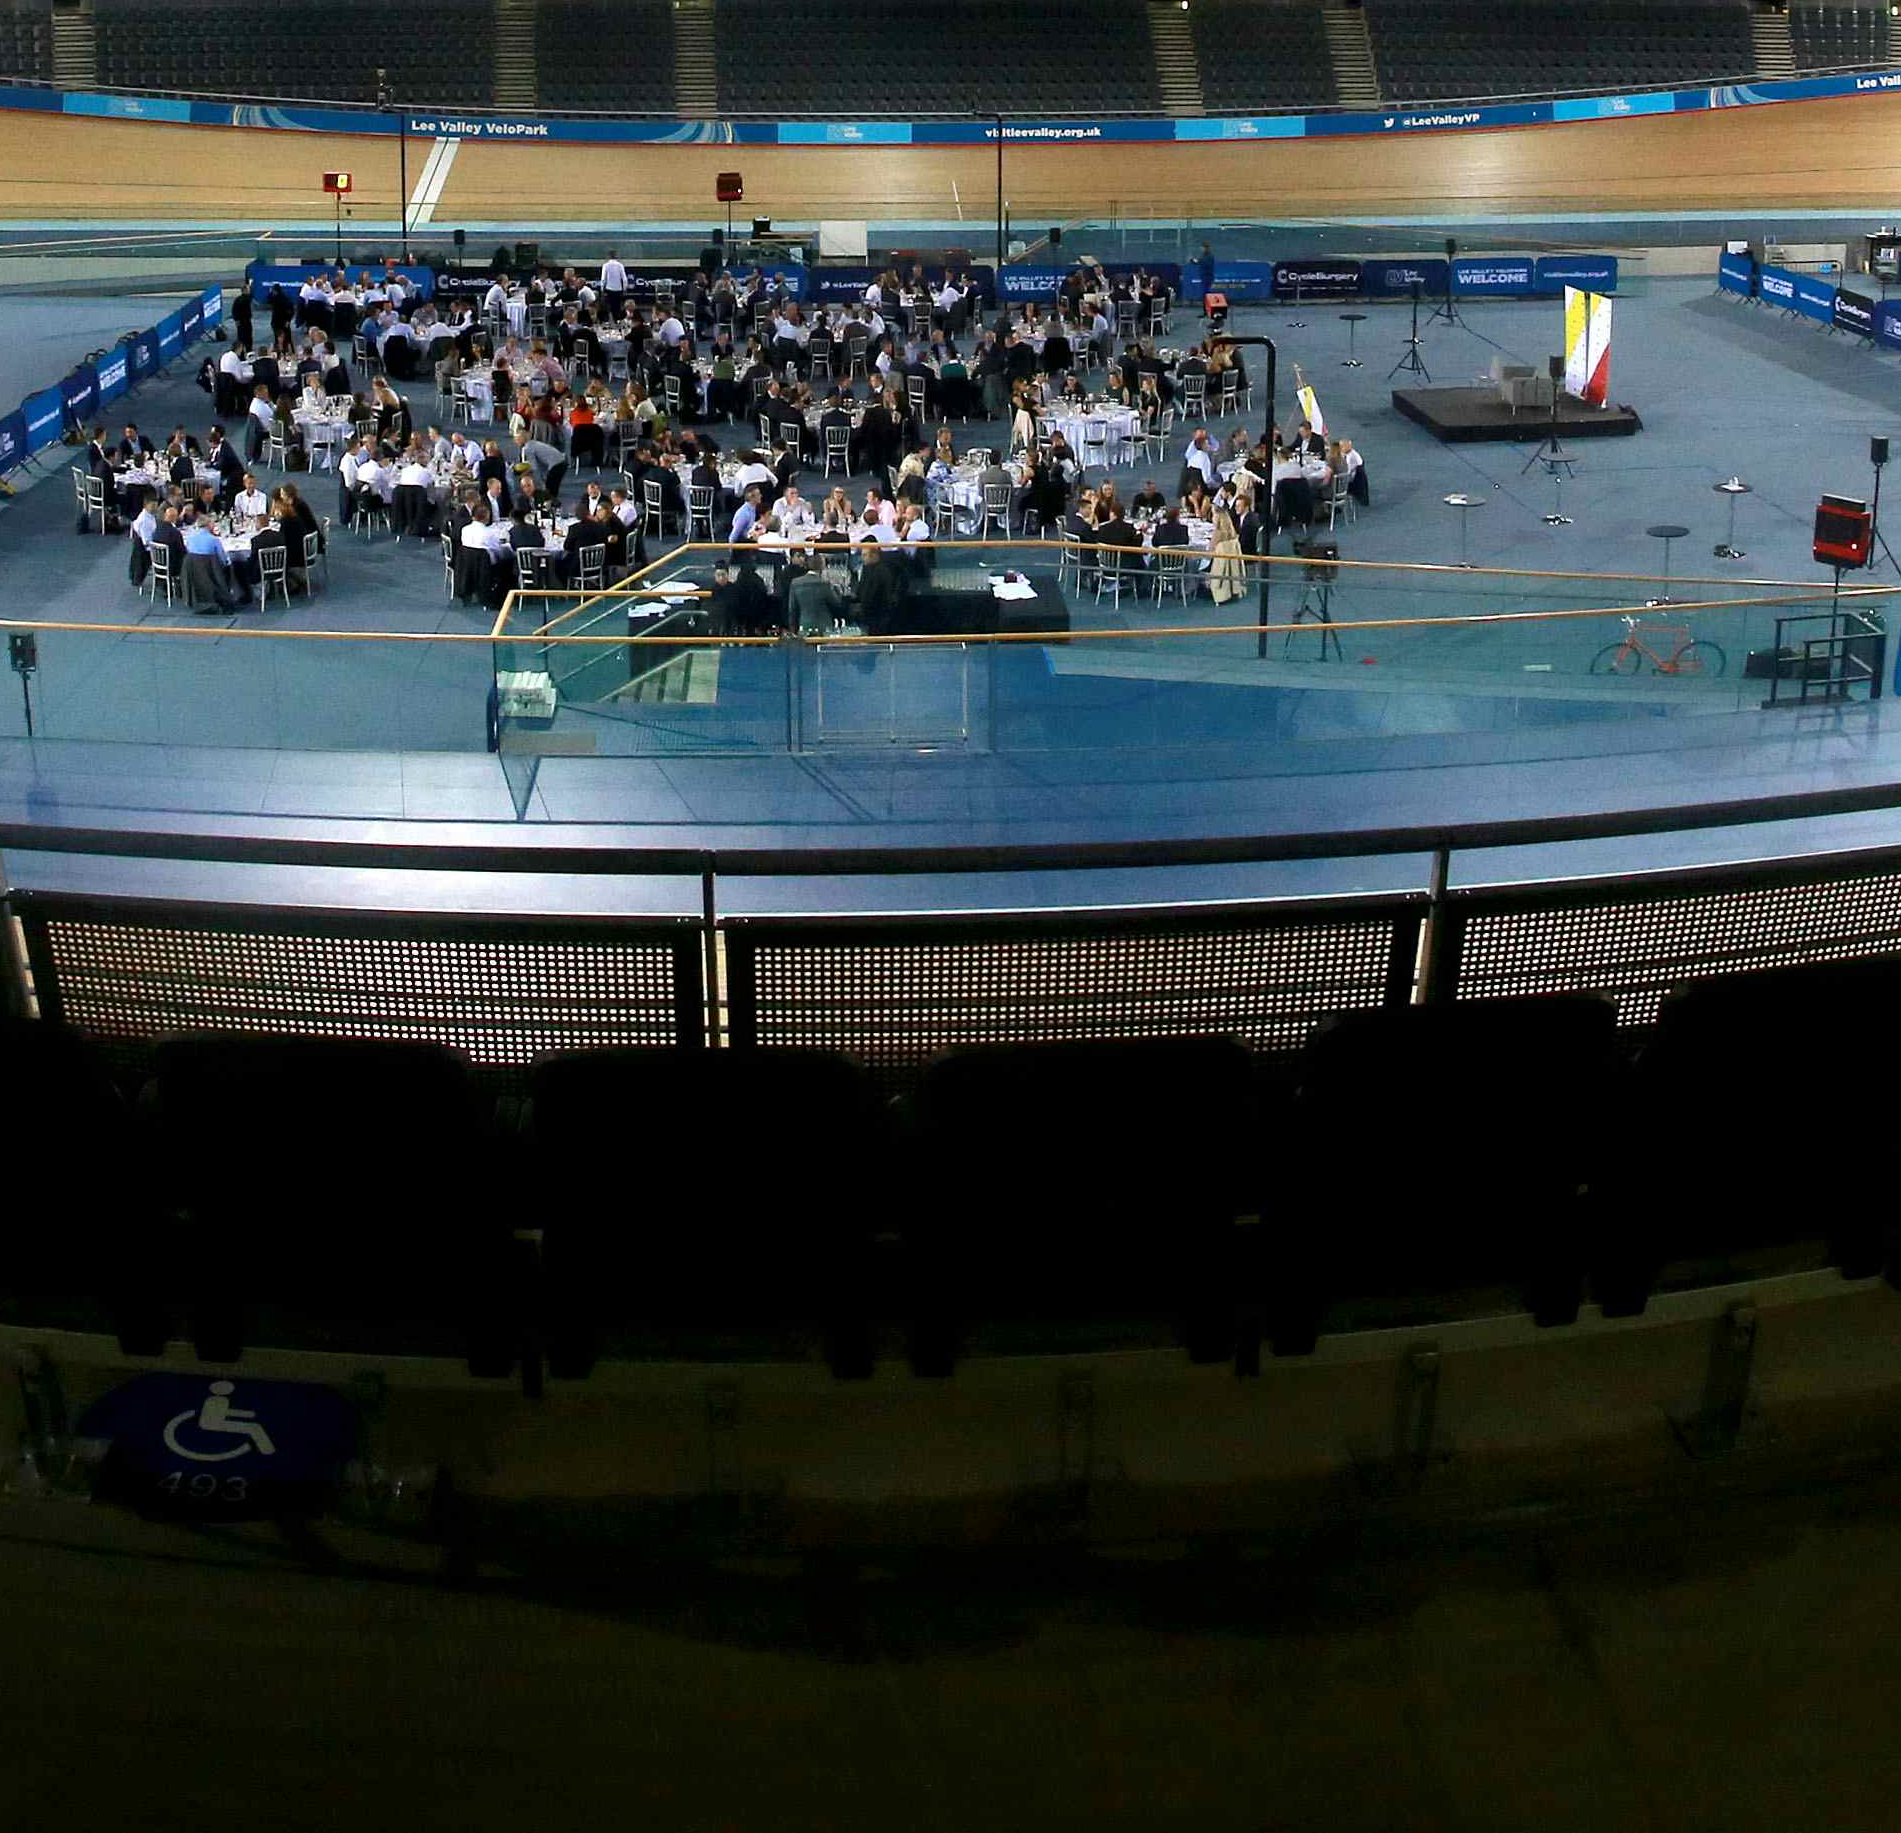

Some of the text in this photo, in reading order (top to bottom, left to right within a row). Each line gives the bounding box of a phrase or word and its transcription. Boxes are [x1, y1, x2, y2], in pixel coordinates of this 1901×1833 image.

[1856, 79, 1876, 89] Lee
[1403, 113, 1480, 126] @LeeValleyVP
[411, 120, 548, 136] Lee Valley VeloPark
[1288, 271, 1358, 283] CycleSurgery
[1458, 274, 1528, 284] WELCOME
[156, 1471, 248, 1502] 493
